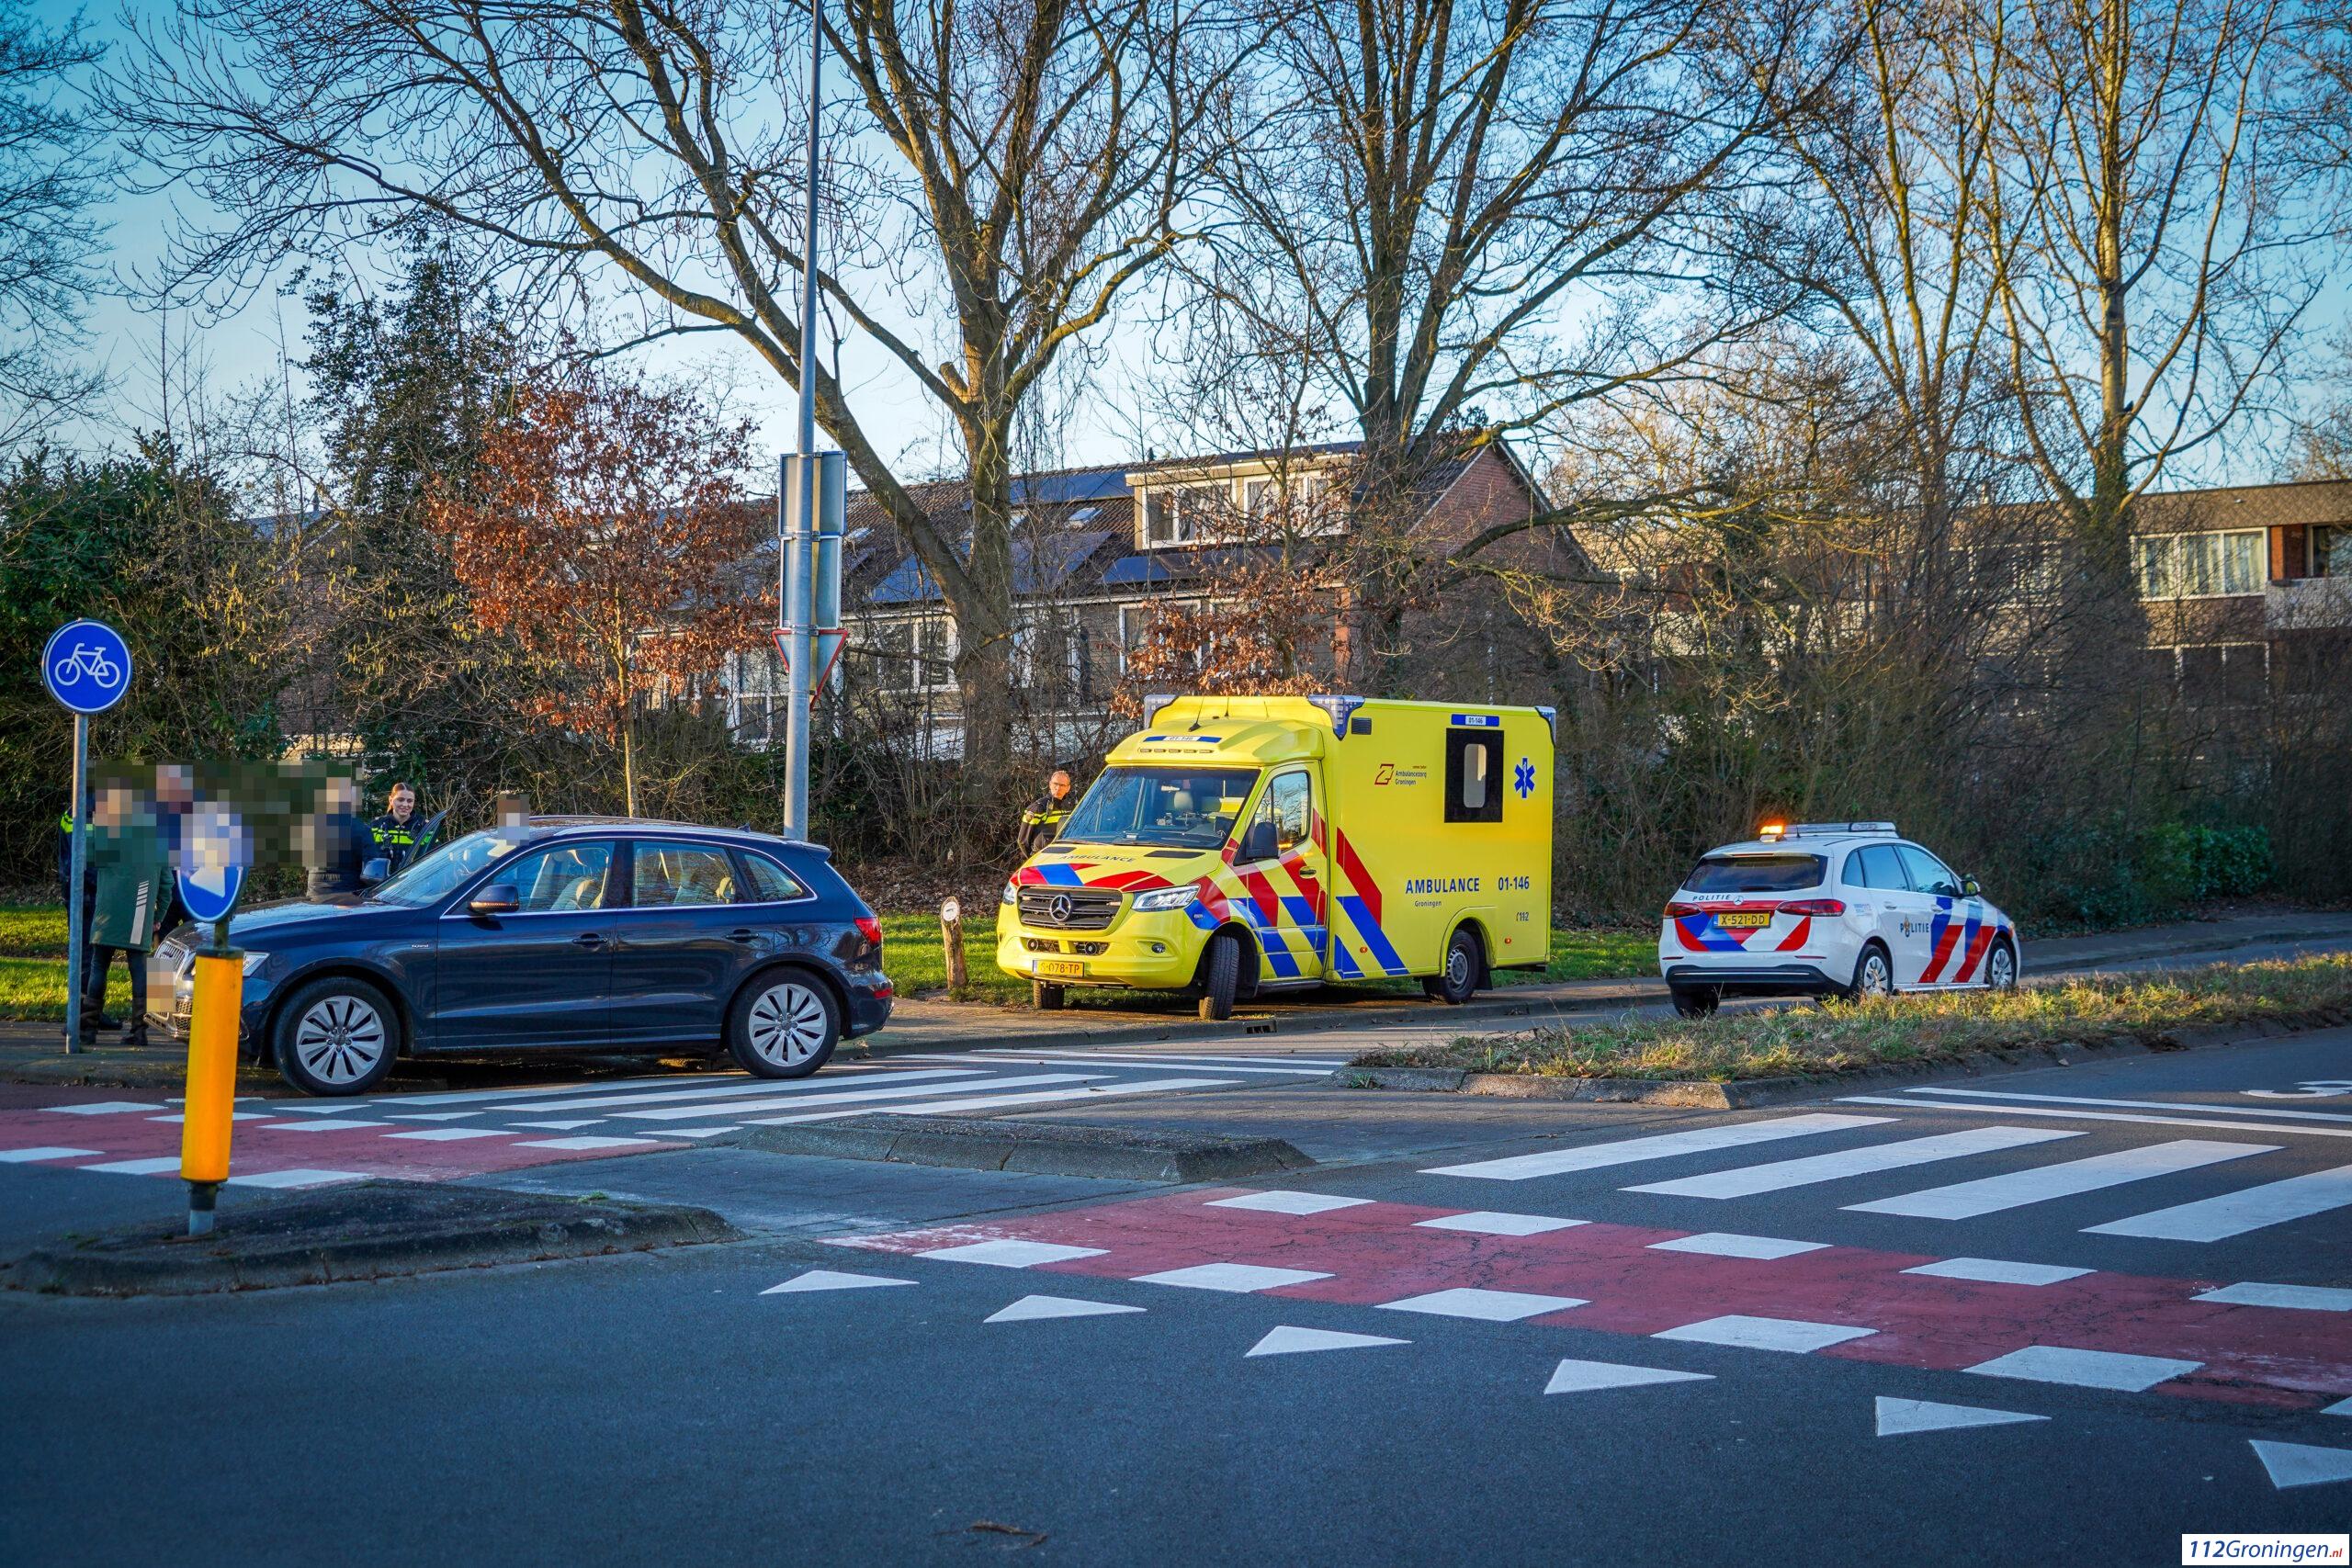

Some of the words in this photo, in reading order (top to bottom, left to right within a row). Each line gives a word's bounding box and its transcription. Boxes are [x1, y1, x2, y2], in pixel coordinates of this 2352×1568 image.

[1396, 771, 1427, 779] Ambulancezorg
[1395, 778, 1417, 786] Groningen
[1406, 877, 1480, 894] AMBULANCE
[1498, 875, 1530, 891] 01-146
[1721, 915, 1765, 925] X-521-DD
[1040, 962, 1080, 974] S-078-TP
